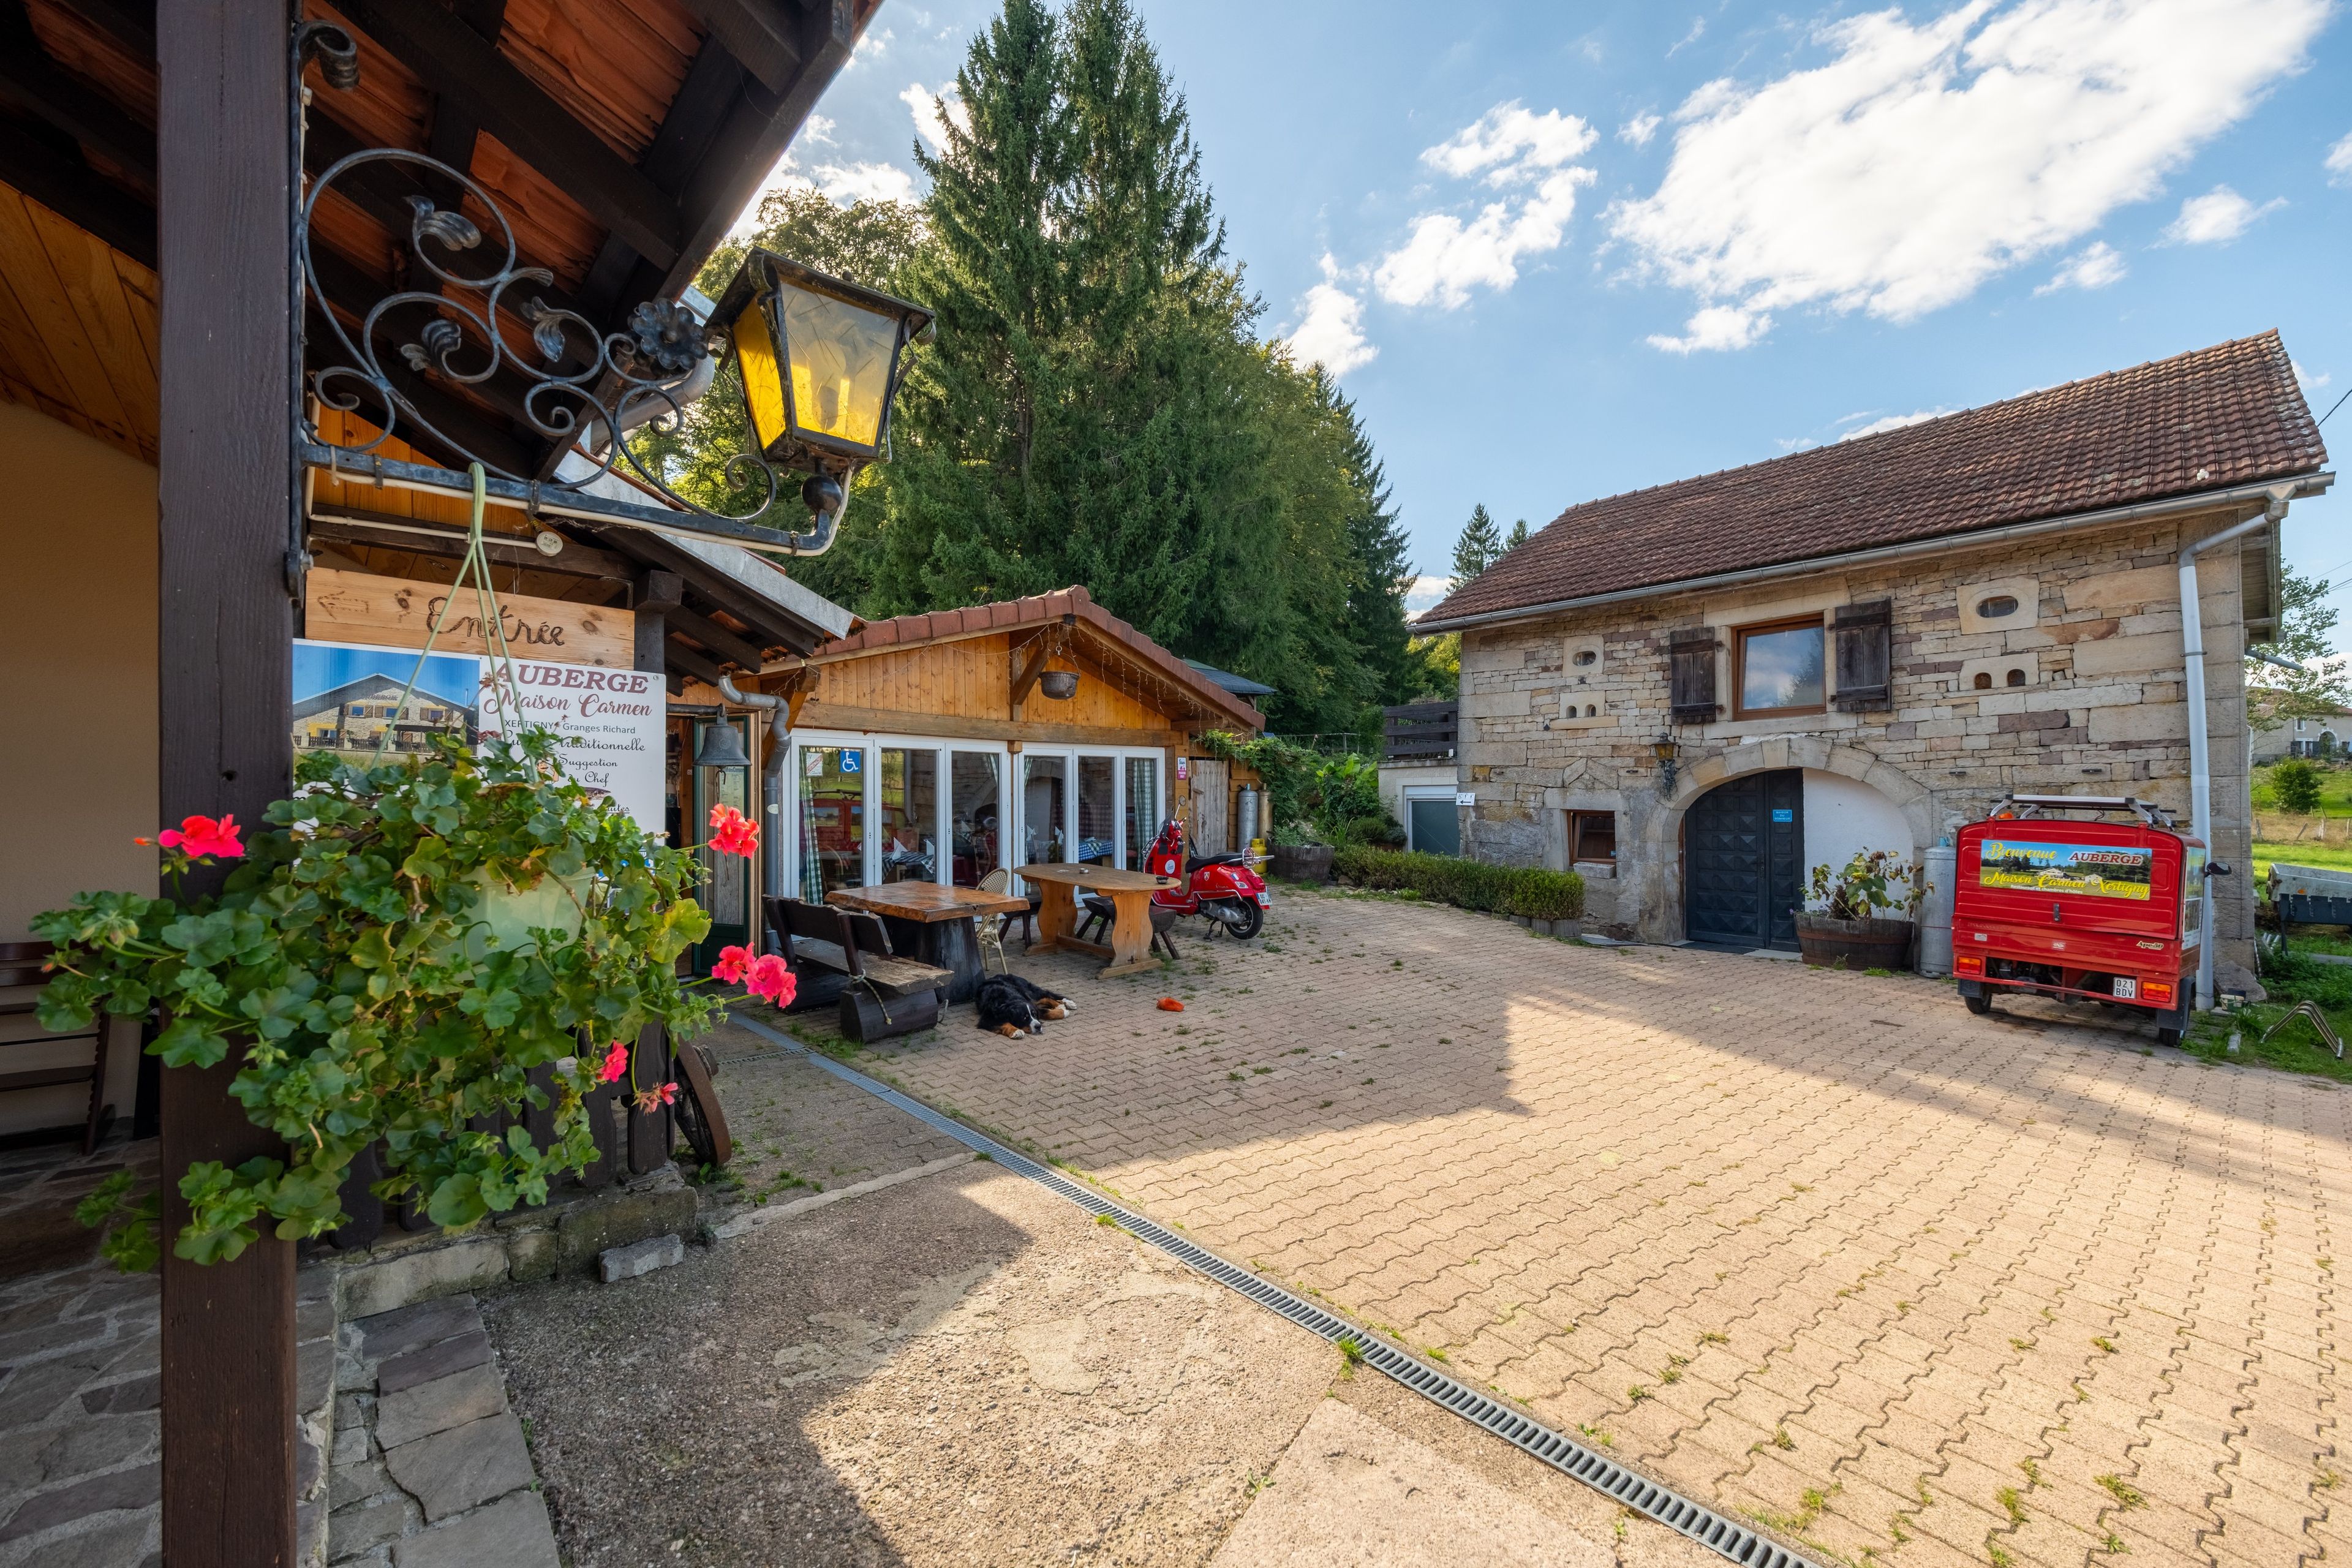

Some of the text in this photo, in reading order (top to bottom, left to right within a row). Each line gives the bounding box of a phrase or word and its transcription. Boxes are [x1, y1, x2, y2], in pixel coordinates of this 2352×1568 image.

[426, 596, 565, 646] Entrée
[494, 662, 649, 694] AUBERGE
[483, 688, 653, 717] Maison Carmen
[562, 722, 600, 733] Granges
[603, 725, 636, 734] Richard
[557, 753, 618, 770] Suggestion
[585, 771, 609, 788] Chef
[1986, 842, 2142, 864] Bienvenue AUBERGE
[1984, 872, 2150, 899] Maison Carmen Xertigny
[2116, 979, 2133, 989] 021
